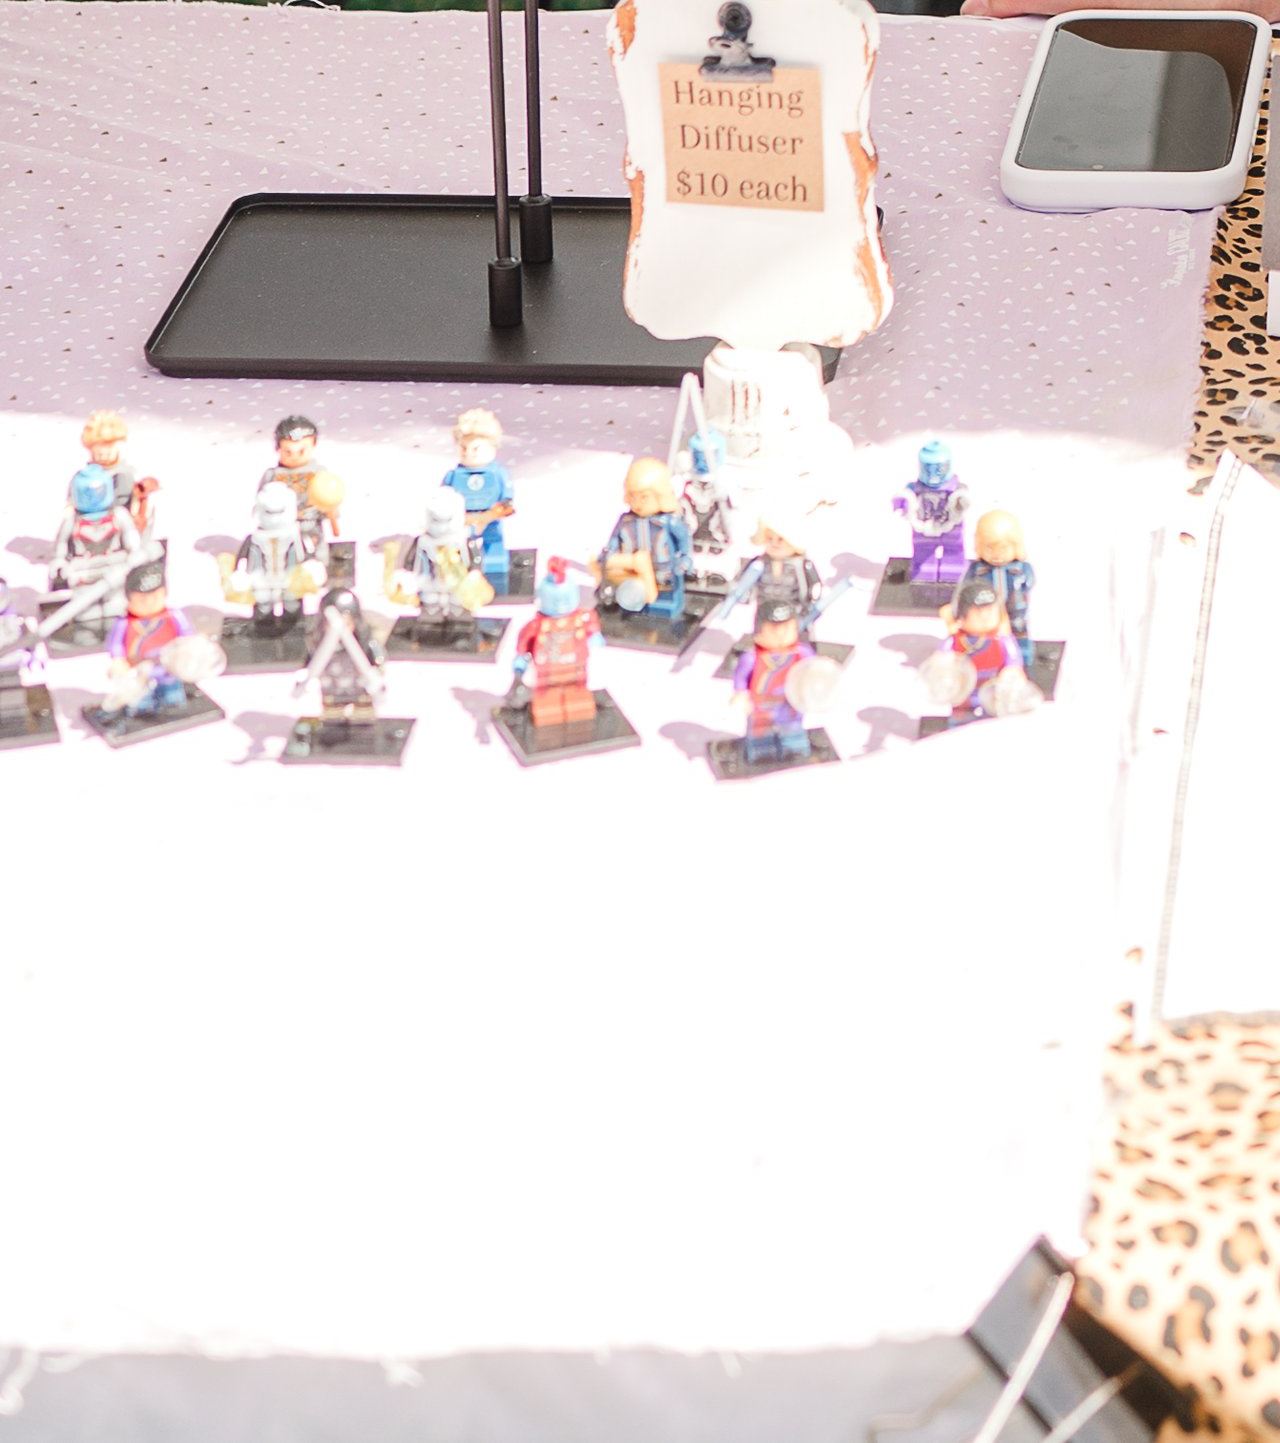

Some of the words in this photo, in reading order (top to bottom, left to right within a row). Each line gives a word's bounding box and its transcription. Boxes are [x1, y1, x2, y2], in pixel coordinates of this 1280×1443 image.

[672, 78, 805, 119] Hanging
[679, 123, 805, 157] Diffuser
[675, 169, 730, 201] $10
[738, 174, 809, 204] each
